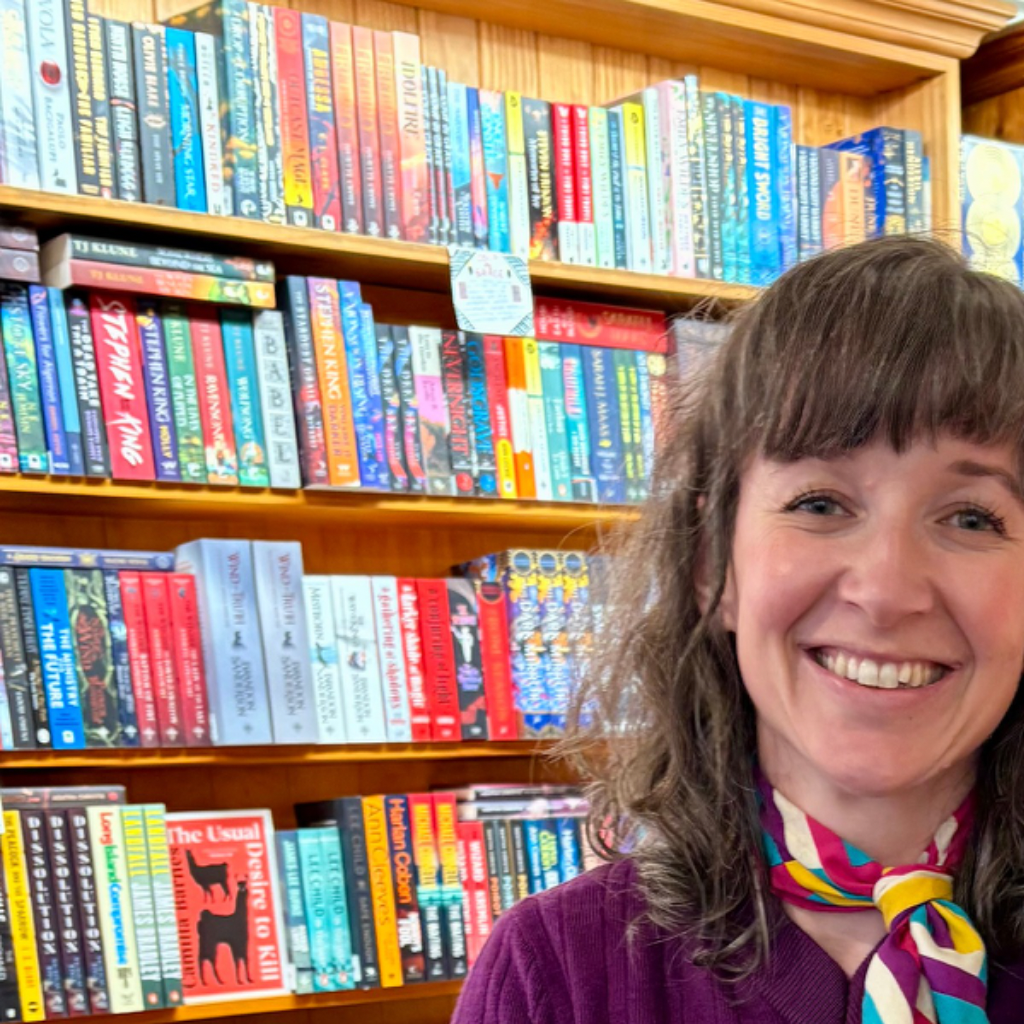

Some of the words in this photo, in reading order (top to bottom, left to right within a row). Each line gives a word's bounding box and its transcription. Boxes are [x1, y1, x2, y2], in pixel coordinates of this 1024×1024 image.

[401, 61, 420, 141] IDOLFIRE
[178, 104, 194, 165] MORNING
[537, 130, 551, 170] STEVEN
[751, 117, 771, 170] BRIGHT
[206, 123, 221, 193] KINDRED
[183, 168, 197, 200] STAR
[754, 172, 772, 221] SWORD
[74, 240, 87, 253] TJ
[89, 242, 138, 258] KLUNE
[37, 305, 50, 341] Flowers
[296, 305, 312, 365] STARDUST
[314, 284, 338, 357] STEPHEN
[82, 334, 97, 370] DEAD
[96, 296, 135, 401] STEPHEN
[146, 320, 164, 383] STEPHEN
[591, 351, 605, 387] SARAH
[16, 362, 33, 391] SKY
[43, 360, 57, 403] Algernon
[75, 361, 89, 401] TRAIN
[87, 373, 101, 407] TAKE
[323, 359, 343, 400] KING
[444, 333, 469, 455] NEVERNIGHT
[151, 385, 171, 422] KING
[467, 341, 493, 455] GODSGRAVE
[106, 410, 144, 468] KING
[328, 404, 342, 457] DARKER
[495, 404, 507, 437] JUSTICE
[597, 402, 609, 437] MAAS
[158, 425, 173, 458] HOLLY
[227, 552, 241, 585] WIND
[277, 553, 292, 585] WIND
[232, 590, 246, 625] TRUTH
[282, 592, 296, 625] TRUTH
[309, 586, 324, 641] MISTBORN
[377, 593, 395, 649] gathering
[401, 593, 418, 631] darker
[41, 623, 56, 651] THE
[59, 628, 71, 650] THE
[405, 633, 422, 664] shade
[428, 597, 445, 660] conjuring
[45, 654, 64, 709] FUTURE
[62, 653, 79, 707] MINISTRY
[384, 662, 400, 710] shadows
[409, 675, 426, 709] magic
[436, 674, 453, 706] light
[99, 811, 114, 846] Long
[145, 810, 170, 876] LANDFALL
[167, 825, 202, 845] The
[206, 822, 261, 843] Usual
[366, 803, 384, 843] Ann
[388, 798, 408, 852] Harlan
[104, 845, 120, 884] Island
[122, 810, 148, 878] LANDFALL
[470, 841, 485, 882] WIZARD
[28, 815, 57, 954] DISSOLUTION
[50, 815, 78, 953] DISSOLUTION
[73, 815, 101, 952] DISSOLUTION
[169, 846, 188, 911] Barnes
[245, 843, 269, 911] Desire
[308, 854, 321, 881] LEE
[328, 852, 340, 879] LEE
[371, 846, 391, 926] Cleeves
[393, 852, 413, 904] Coben
[131, 881, 154, 926] JAMES
[152, 881, 175, 925] JAMES
[310, 884, 325, 917] CHILD
[331, 884, 345, 916] CHILD
[426, 906, 438, 920] THE
[446, 905, 459, 919] THE
[474, 889, 490, 935] KREMLIN
[489, 876, 501, 915] POIROT
[15, 899, 28, 941] SPARROW
[108, 882, 128, 966] Compromise
[255, 916, 272, 939] to
[428, 922, 443, 959] WAITING
[449, 920, 464, 957] WAITING
[136, 926, 162, 981] BRADLEY
[158, 925, 182, 980] BRADLEY
[177, 918, 198, 989] Camilla
[257, 945, 280, 981] Kill
